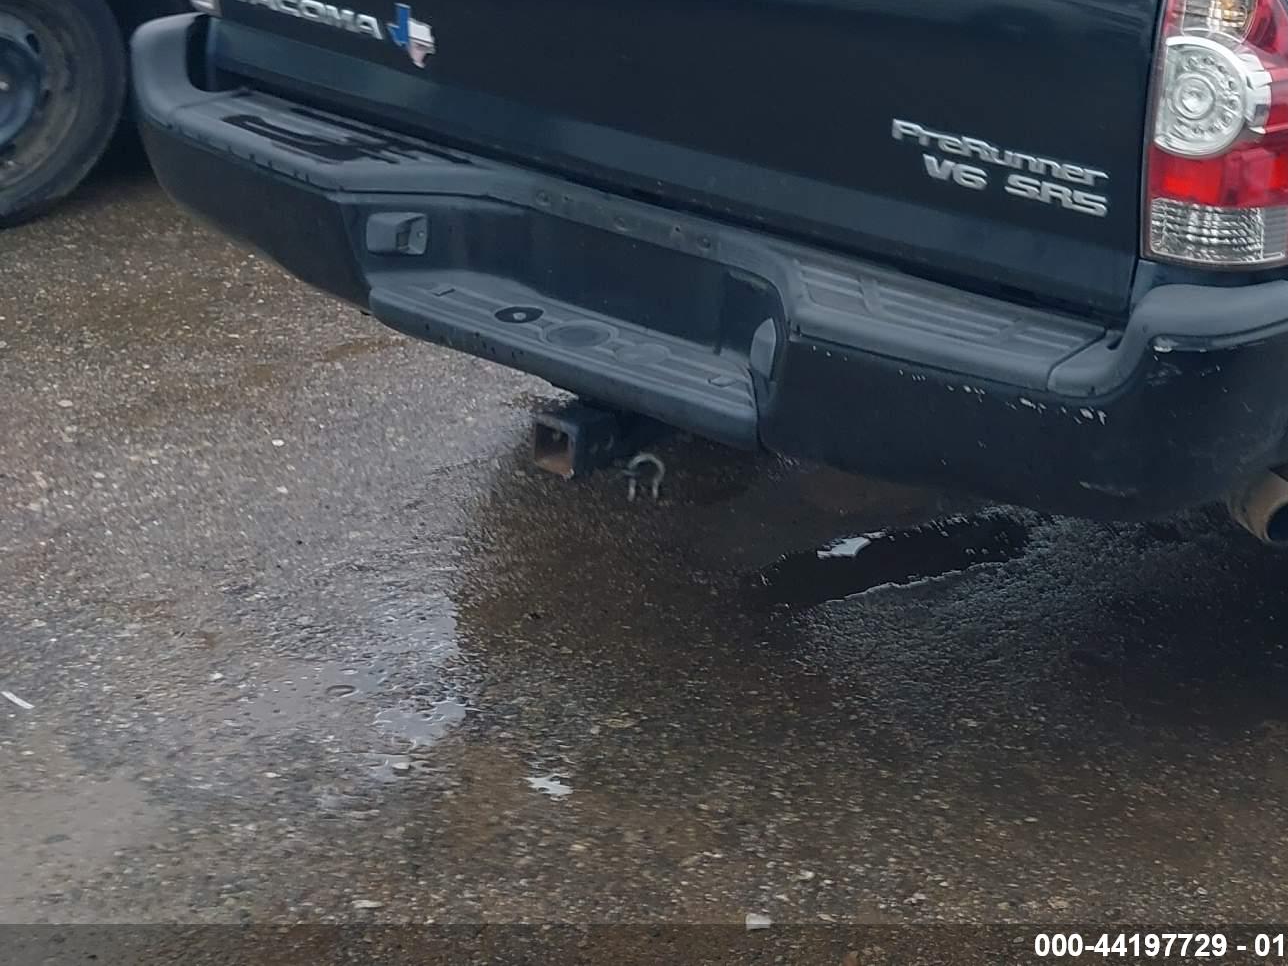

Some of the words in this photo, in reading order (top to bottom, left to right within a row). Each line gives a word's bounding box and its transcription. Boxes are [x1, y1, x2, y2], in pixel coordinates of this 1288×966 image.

[892, 118, 1109, 186] PreRunner
[922, 153, 989, 190] V6
[1004, 173, 1109, 217] SR5
